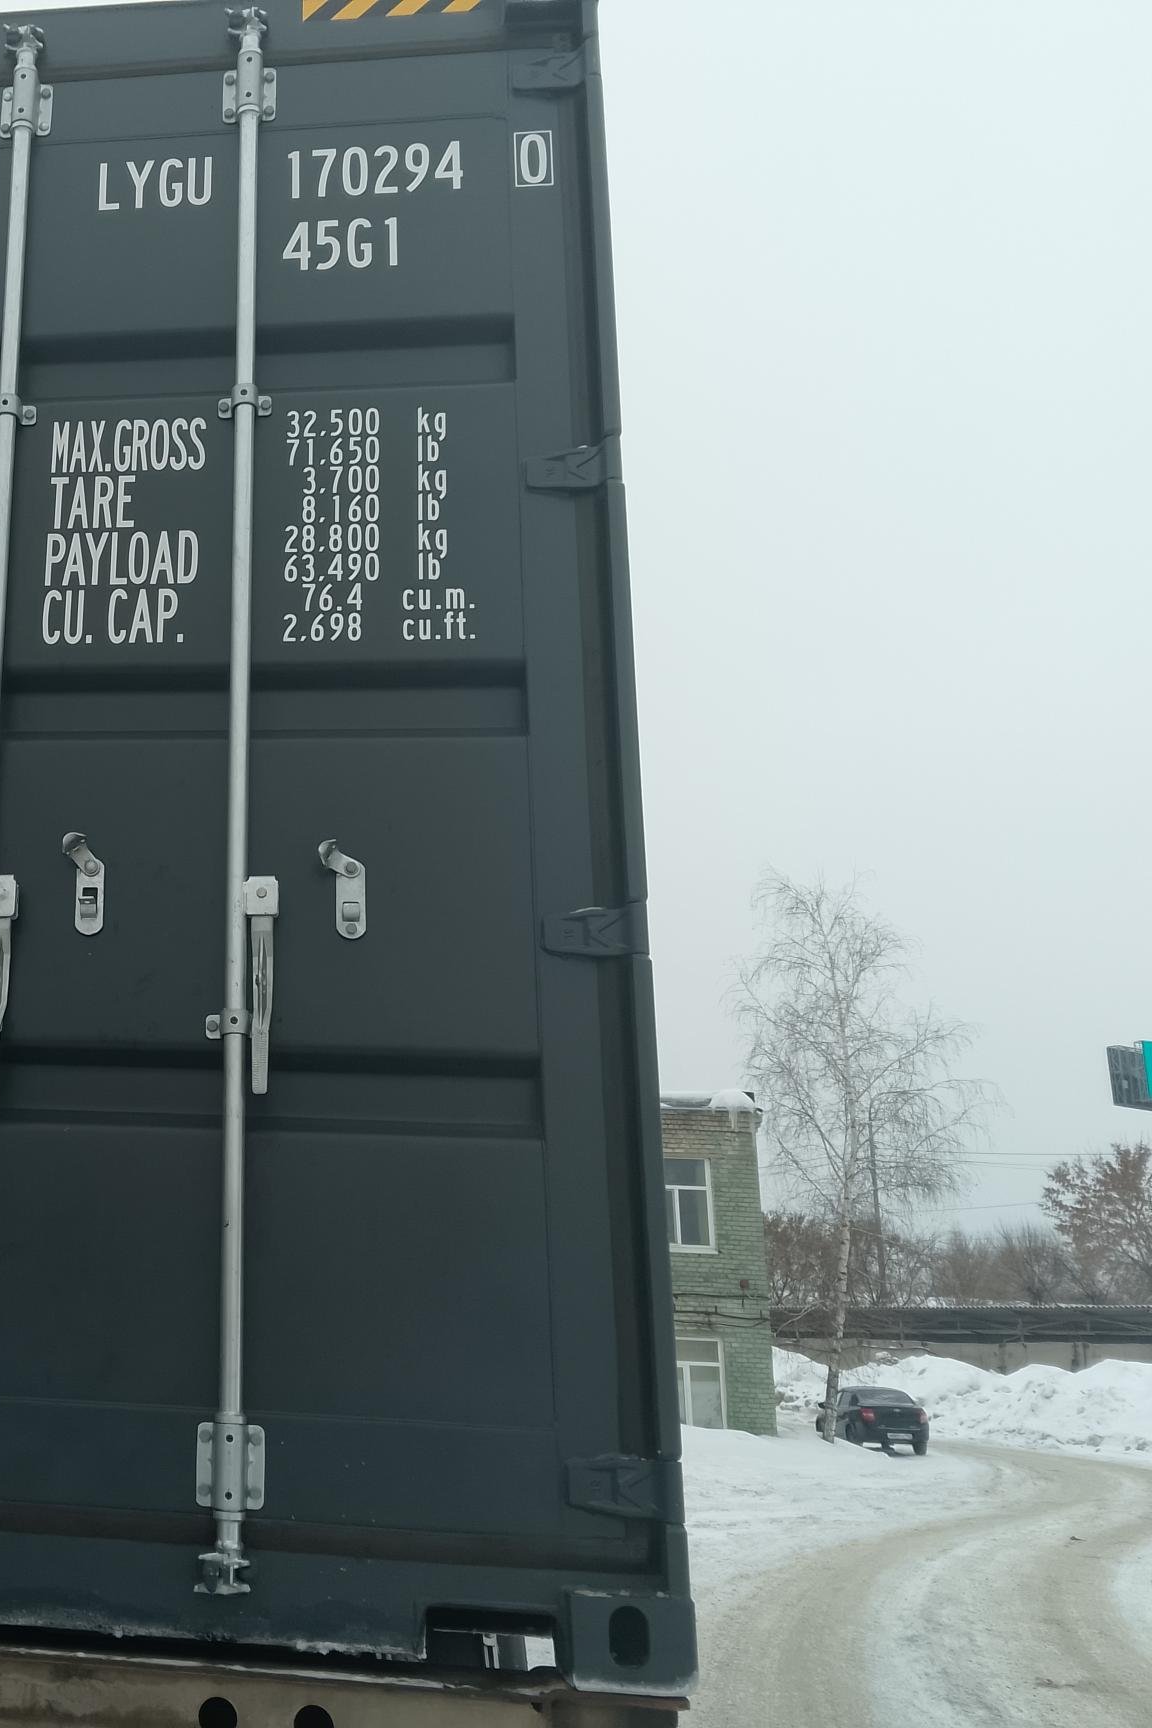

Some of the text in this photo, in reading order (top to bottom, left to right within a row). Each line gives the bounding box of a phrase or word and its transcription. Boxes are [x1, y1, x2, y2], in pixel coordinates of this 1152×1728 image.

[97, 134, 548, 211] LYGU 170294 0
[282, 216, 398, 271] 45G1
[417, 407, 446, 441] kg
[50, 417, 207, 473] MAX.GROSS
[417, 435, 439, 462] lb
[417, 464, 447, 499] kg
[50, 475, 137, 529] TARE
[417, 493, 440, 520] lb
[44, 529, 199, 586] PAYLOAD
[418, 523, 447, 558] kg
[418, 552, 440, 580] lb
[302, 583, 362, 611] 76.4
[42, 587, 184, 644] CU. CAP.
